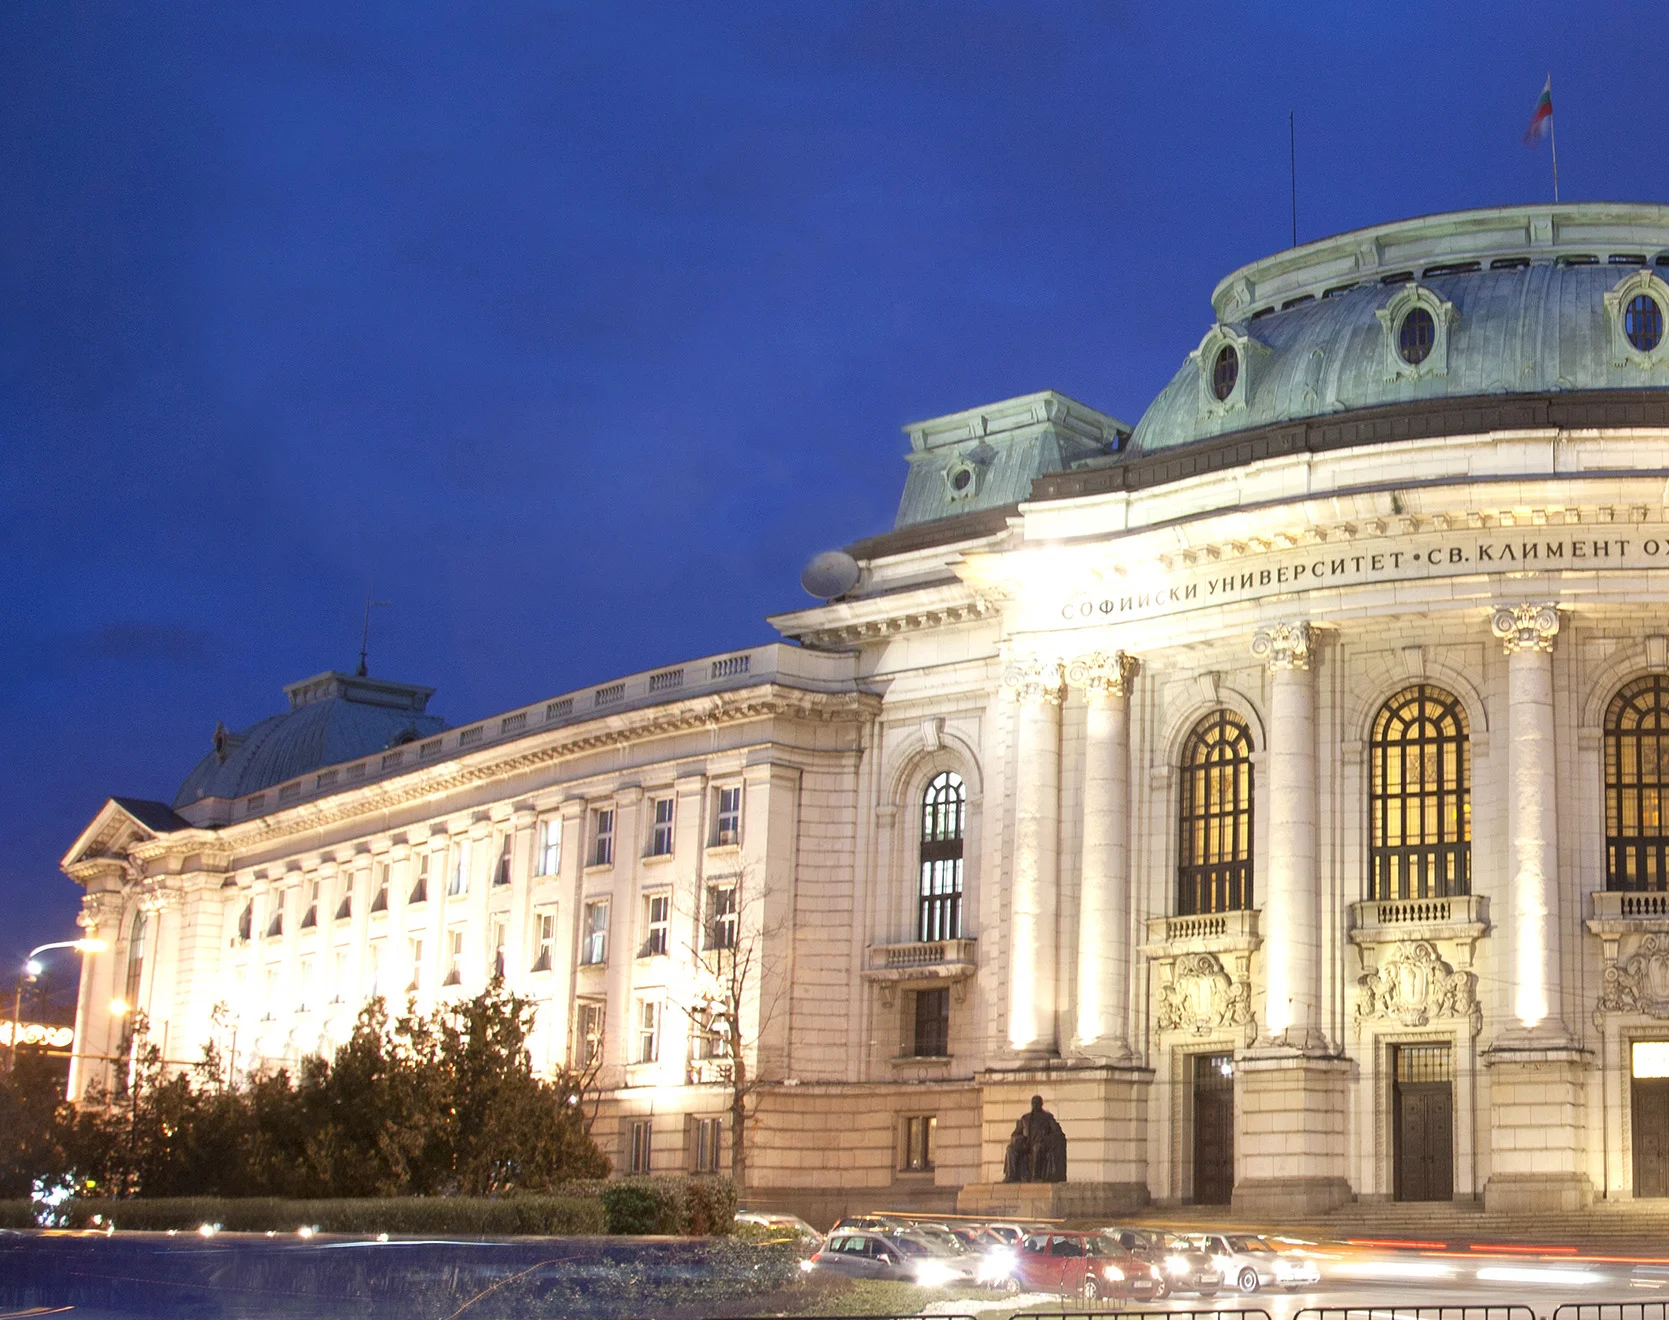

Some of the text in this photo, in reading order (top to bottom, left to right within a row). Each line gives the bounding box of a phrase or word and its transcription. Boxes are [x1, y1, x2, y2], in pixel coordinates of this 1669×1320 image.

[1208, 552, 1404, 595] УНИВЕРСИТЕТ
[1428, 548, 1469, 565] СВ.
[1479, 540, 1630, 561] КЛИМЕНТ
